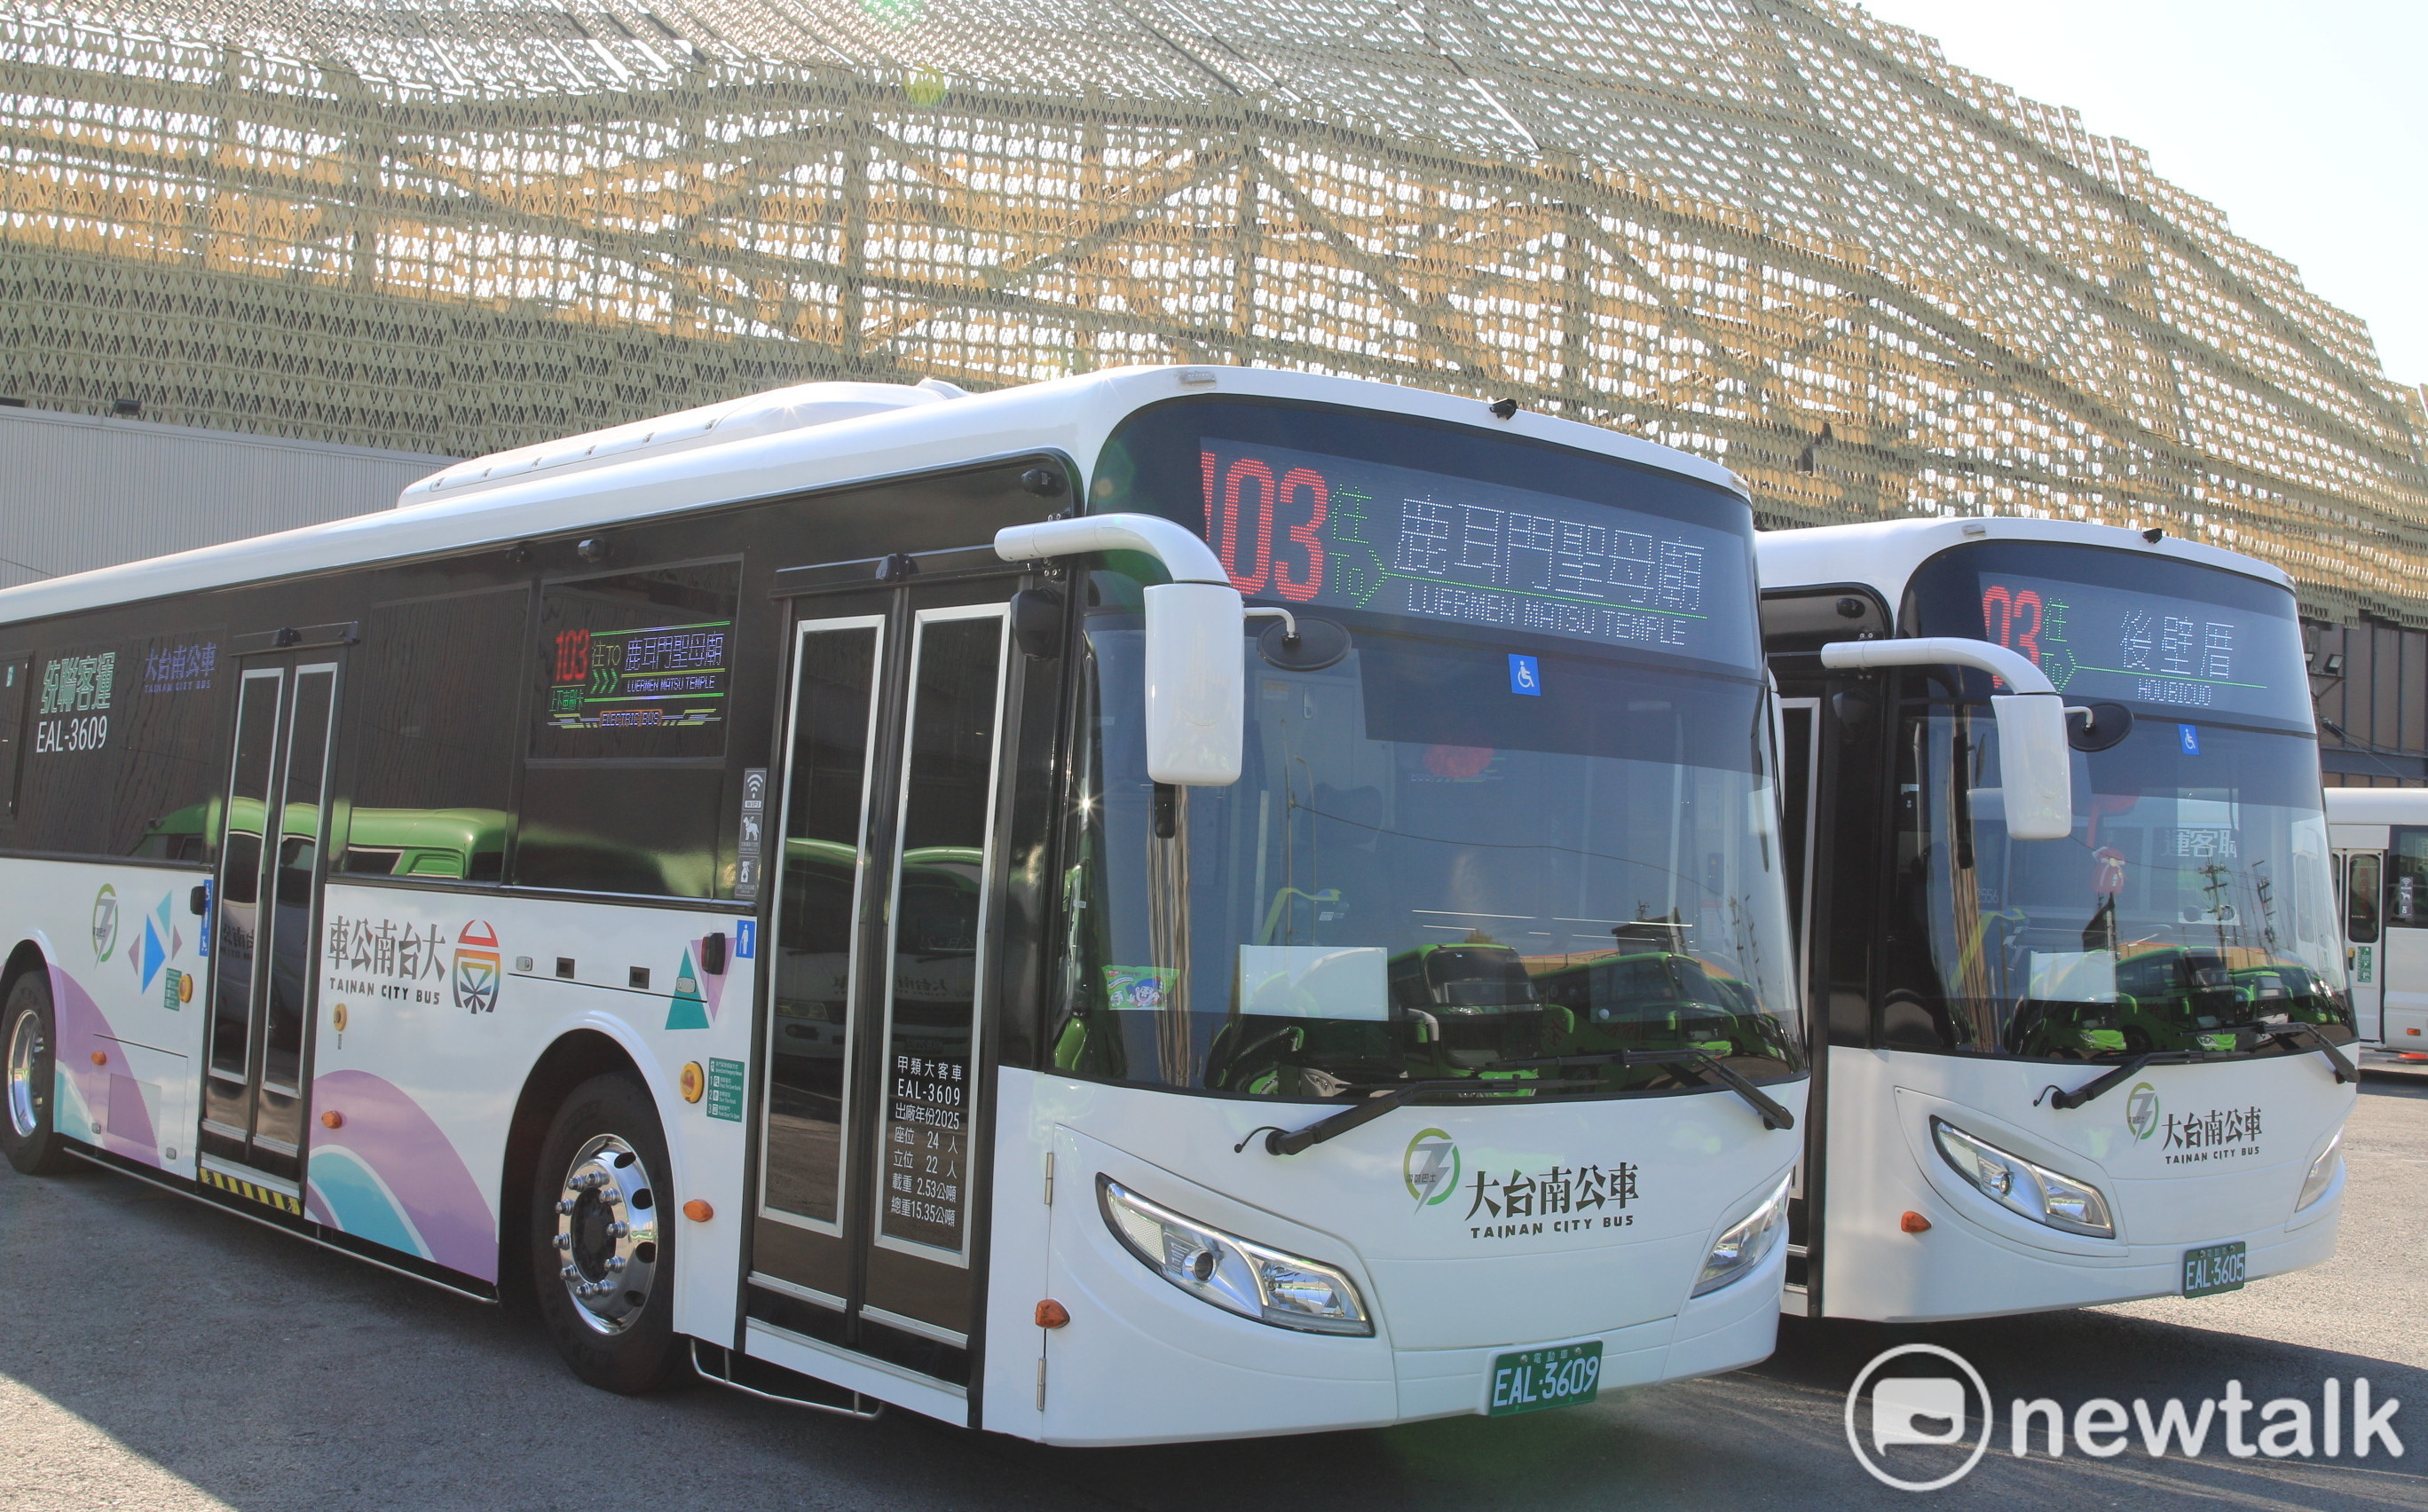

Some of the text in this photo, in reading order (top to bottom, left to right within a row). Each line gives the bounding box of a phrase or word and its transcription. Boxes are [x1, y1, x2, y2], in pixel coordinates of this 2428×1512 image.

[1328, 484, 1373, 546] 往
[1393, 493, 1706, 611] 鹿耳門聖母廟
[1407, 583, 1687, 646] LUERMEN MATSU TEMPLE
[2043, 597, 2069, 642] 往
[556, 628, 590, 681] 103
[625, 631, 724, 671] 鹿耳門聖母廟
[2120, 610, 2235, 680] 後壁厝
[144, 642, 217, 682] 大台南公車
[40, 651, 116, 714] 統聯客運
[660, 677, 684, 690] MATSU
[685, 675, 715, 689] TEMPLE
[2138, 678, 2211, 705] HOUBICUO
[36, 715, 107, 753] EAL-3609
[602, 712, 660, 727] ELECTRIC BUS
[330, 977, 440, 1005] TAINAN CITY BUS
[897, 1055, 962, 1083] 甲類大客車
[897, 1078, 960, 1106] EAL-3609
[895, 1102, 959, 1130] 出廠年份2025
[2161, 1106, 2263, 1152] 大台南公車
[894, 1126, 958, 1154] 座位 24 人
[2165, 1146, 2259, 1165] TAINAN CITY BUS
[893, 1149, 958, 1179] 立位 22 人
[892, 1172, 958, 1204] 載重 2.53公噸
[1464, 1162, 1640, 1223] 大台南公車
[891, 1195, 956, 1228] 總重15.35公噸
[1470, 1215, 1634, 1240] TAINAN CITY BUS
